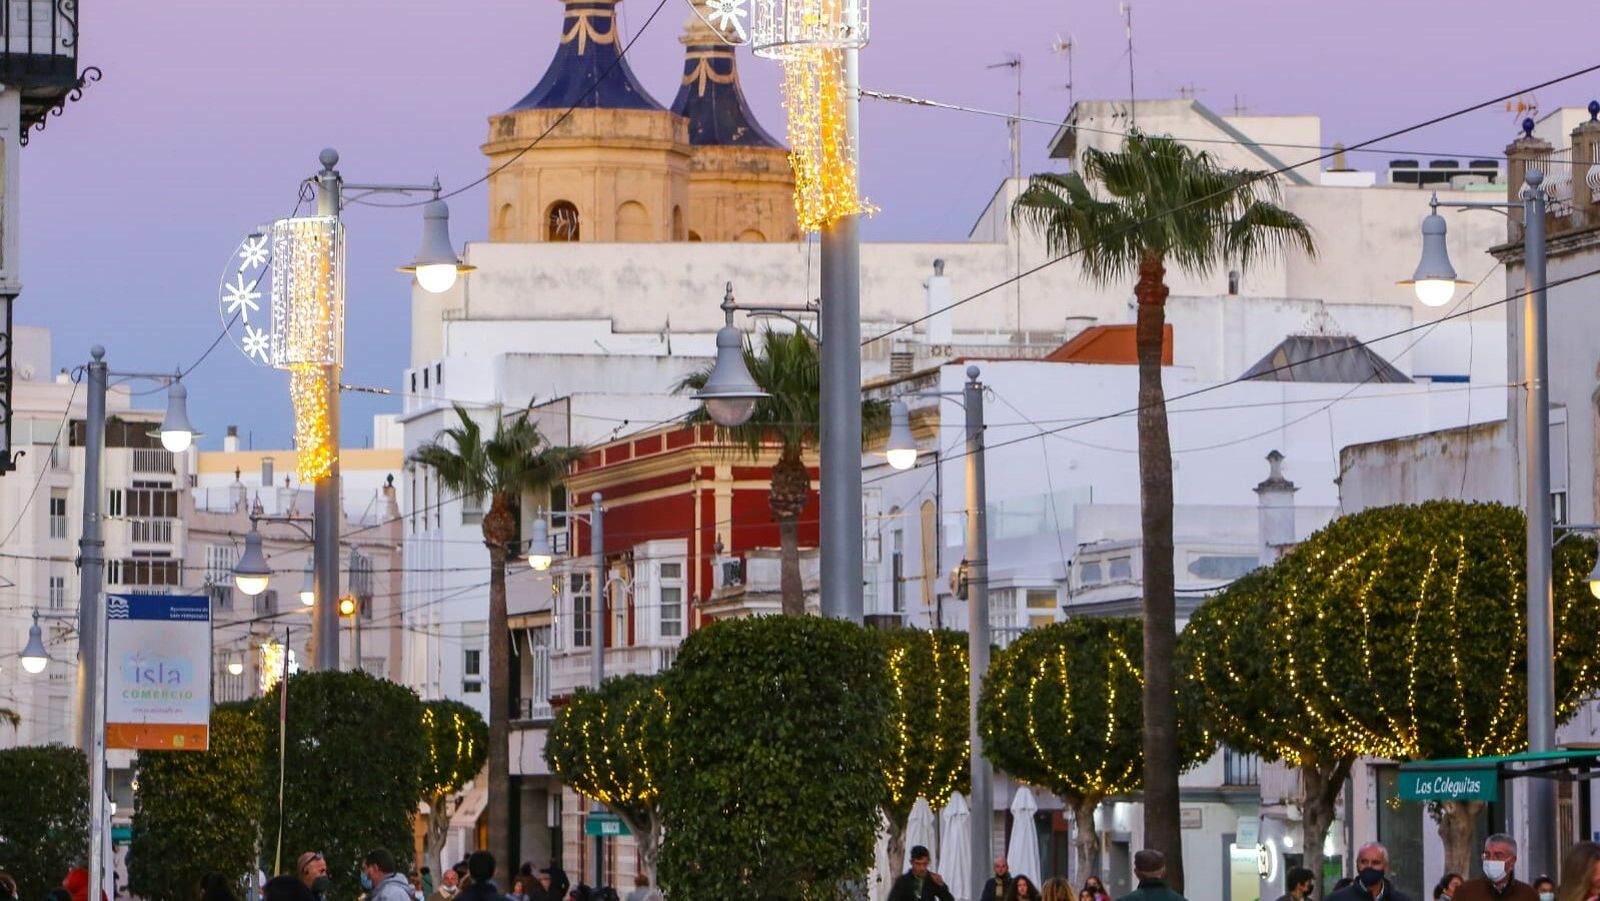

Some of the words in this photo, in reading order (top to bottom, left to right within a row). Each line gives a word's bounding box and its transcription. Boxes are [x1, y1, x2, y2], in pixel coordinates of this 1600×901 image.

[134, 661, 180, 684] isla
[122, 689, 193, 699] COMERCIO
[1416, 777, 1432, 794] Los
[1433, 776, 1480, 798] Coleguitas
